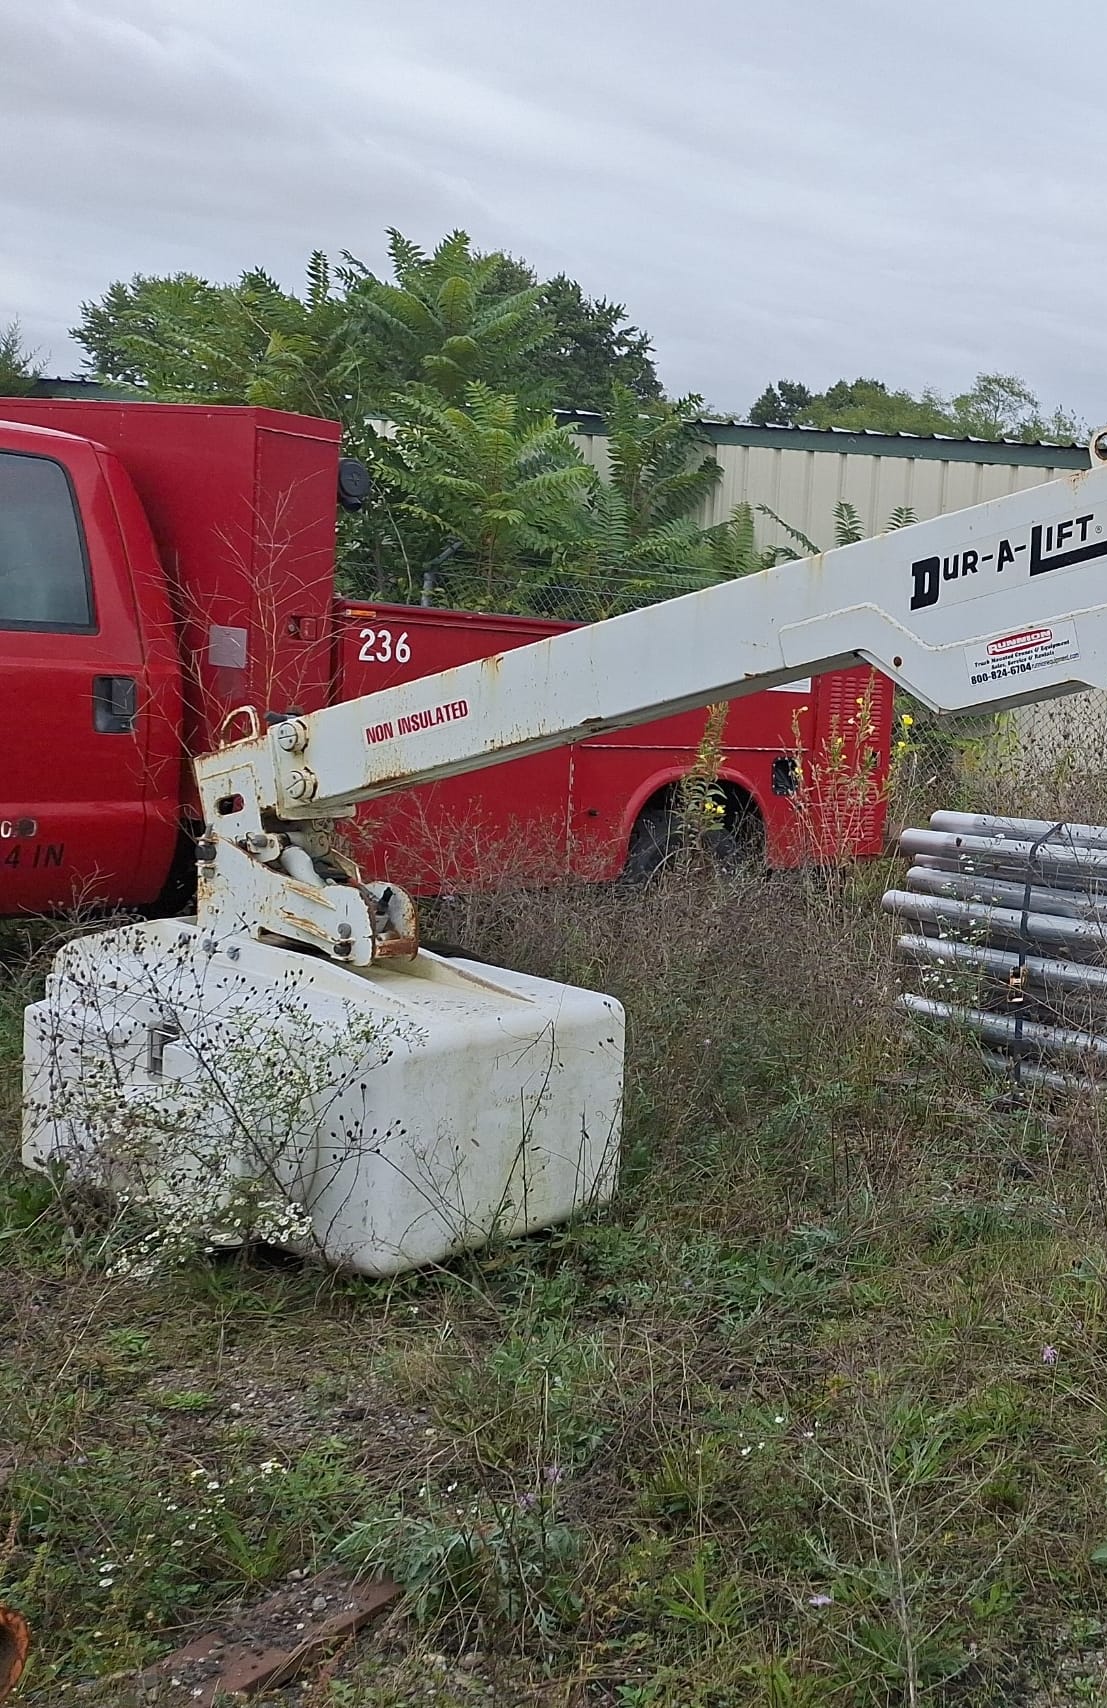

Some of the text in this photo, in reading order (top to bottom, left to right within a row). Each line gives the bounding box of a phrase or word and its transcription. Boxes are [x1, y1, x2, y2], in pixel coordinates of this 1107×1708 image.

[358, 628, 411, 663] 236
[987, 630, 1052, 655] RUNNION
[1041, 640, 1070, 650] Equipment
[970, 661, 1032, 685] 800-824-6704
[365, 700, 469, 745] NON INSULATED
[33, 843, 64, 869] IN
